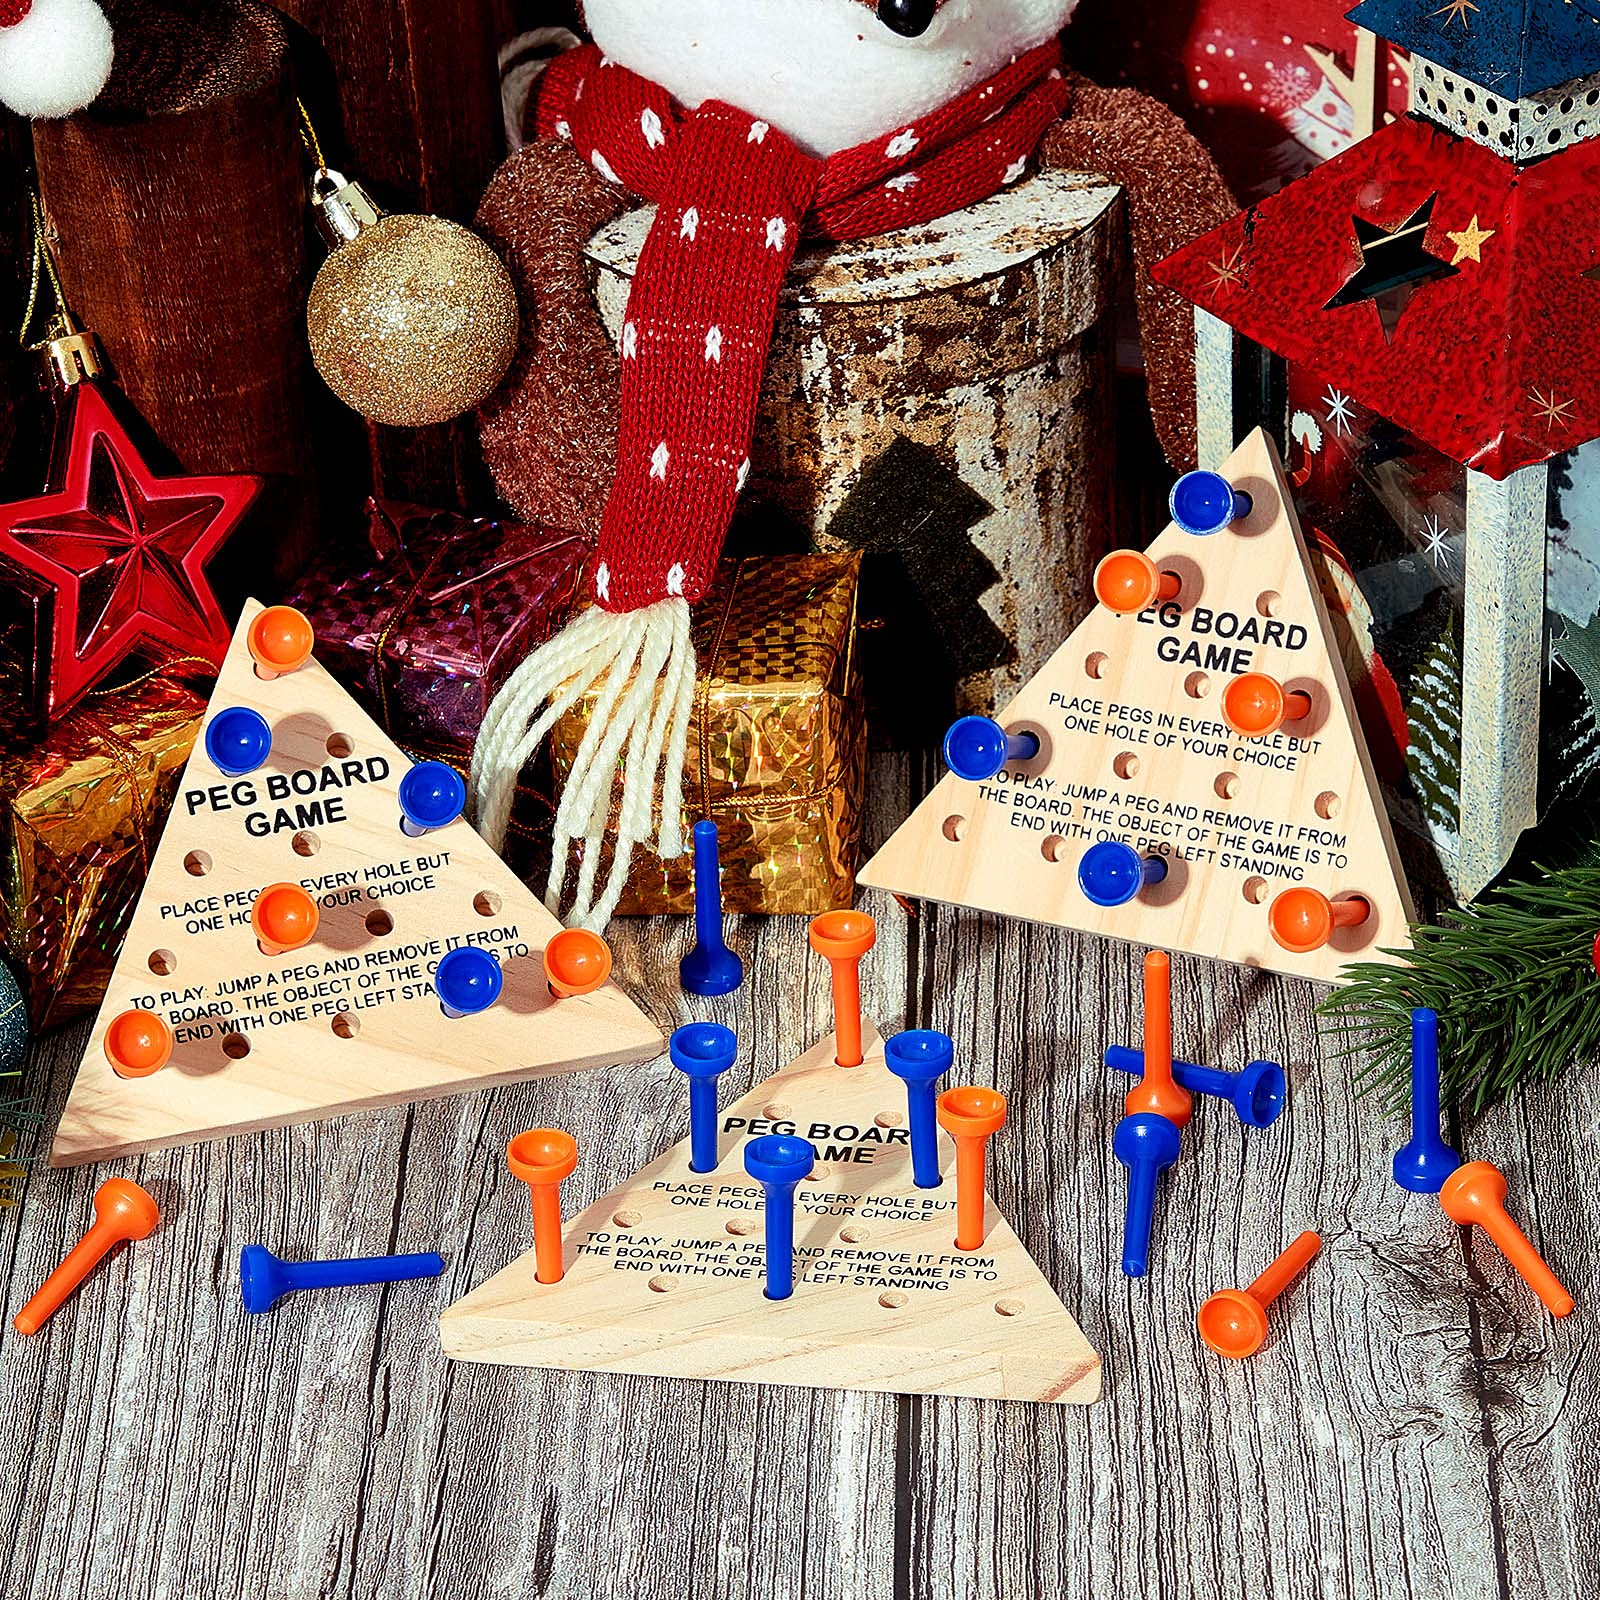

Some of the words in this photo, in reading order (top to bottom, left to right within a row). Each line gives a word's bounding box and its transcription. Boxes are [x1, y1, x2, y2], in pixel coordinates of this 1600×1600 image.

[1116, 600, 1182, 628] EG
[1192, 607, 1307, 650] BOARD
[1158, 637, 1253, 674] GAME
[1049, 693, 1103, 715] PLACE
[1108, 704, 1152, 724] PEGS
[1158, 714, 1174, 728] IN
[1179, 718, 1232, 739] EVERY
[1288, 739, 1321, 755] BUT
[1064, 716, 1099, 734] ONE
[1105, 725, 1148, 743] HOLE
[1154, 733, 1176, 748] OF
[1182, 738, 1227, 758] YOUR
[1233, 747, 1297, 770] CHOICE
[186, 780, 257, 816] PEG
[270, 757, 390, 800] BOARD
[988, 770, 1009, 783] O
[1062, 784, 1107, 801] JUMP
[1110, 793, 1120, 805] A
[1125, 795, 1159, 813] PEG
[1162, 803, 1198, 820] AND
[1203, 810, 1273, 835] REMOVE
[1278, 824, 1293, 838] IT
[1298, 828, 1346, 848] FROM
[245, 798, 347, 837] GAME
[979, 786, 1009, 803] THE
[1014, 793, 1074, 817] BOARD.
[1083, 806, 1113, 824] THE
[1118, 814, 1183, 836] OBJECT
[1188, 827, 1210, 842] OF
[1216, 832, 1247, 850] THE
[1252, 840, 1300, 860] GAME
[1305, 849, 1320, 863] IS
[1327, 853, 1347, 868] TO
[1011, 813, 1045, 830] END
[1050, 821, 1091, 840] WITH
[1097, 830, 1131, 843] ONE
[1136, 837, 1171, 856] PEG
[1176, 845, 1216, 863] LEFT
[1220, 854, 1304, 880] STANDING
[160, 897, 220, 919] PLACE
[224, 888, 267, 907] PEG
[300, 871, 358, 892] EVERY
[364, 861, 412, 880] HOLE
[417, 853, 450, 871] BUT
[186, 916, 224, 934] ONE
[367, 875, 435, 900] CHOICE
[131, 996, 155, 1009] TO
[215, 976, 261, 996] JUMP
[267, 974, 278, 986] A
[282, 965, 319, 982] PEG
[324, 958, 359, 975] AND
[365, 941, 441, 967] REMOVE
[446, 937, 460, 951] IT
[466, 926, 518, 947] FROM
[170, 1001, 238, 1024] BOARD.
[243, 993, 278, 1009] THE
[284, 978, 351, 1002] OBJECT
[358, 972, 380, 988] OF
[386, 964, 422, 982] THE
[504, 944, 528, 959] TO
[175, 1025, 213, 1043] END
[217, 1015, 264, 1035] WITH
[269, 1007, 307, 1025] ONE
[312, 999, 349, 1017] PEG
[354, 989, 395, 1008] LEFT
[724, 1118, 796, 1136] PEG
[808, 1123, 910, 1145] BOAR
[653, 1182, 713, 1194] PLACE
[799, 1192, 861, 1205] EVERY
[867, 1197, 914, 1208] HOLE
[922, 1200, 957, 1210] BUT
[671, 1196, 710, 1206] ONE
[717, 1199, 764, 1210] HOLE
[804, 1205, 855, 1216] YOUR
[861, 1209, 933, 1221] CHOICE
[576, 1245, 611, 1256] THE
[616, 1248, 687, 1261] BOARD.
[695, 1253, 730, 1264] THE
[815, 1260, 840, 1271] OF
[848, 1263, 881, 1274] THE
[888, 1265, 943, 1278] GAME
[950, 1269, 966, 1279] IS
[974, 1271, 997, 1281] TO
[586, 1233, 610, 1242] TO
[671, 1239, 722, 1249] JUMP
[726, 1243, 737, 1251] A
[743, 1244, 766, 1254] PE
[831, 1250, 911, 1263] REMOVE
[917, 1255, 933, 1264] IT
[939, 1255, 994, 1268] FROM
[613, 1260, 653, 1272] END
[660, 1264, 705, 1275] WITH
[712, 1267, 752, 1278] ONE
[802, 1274, 848, 1284] LEFT
[854, 1276, 949, 1291] STANDING
